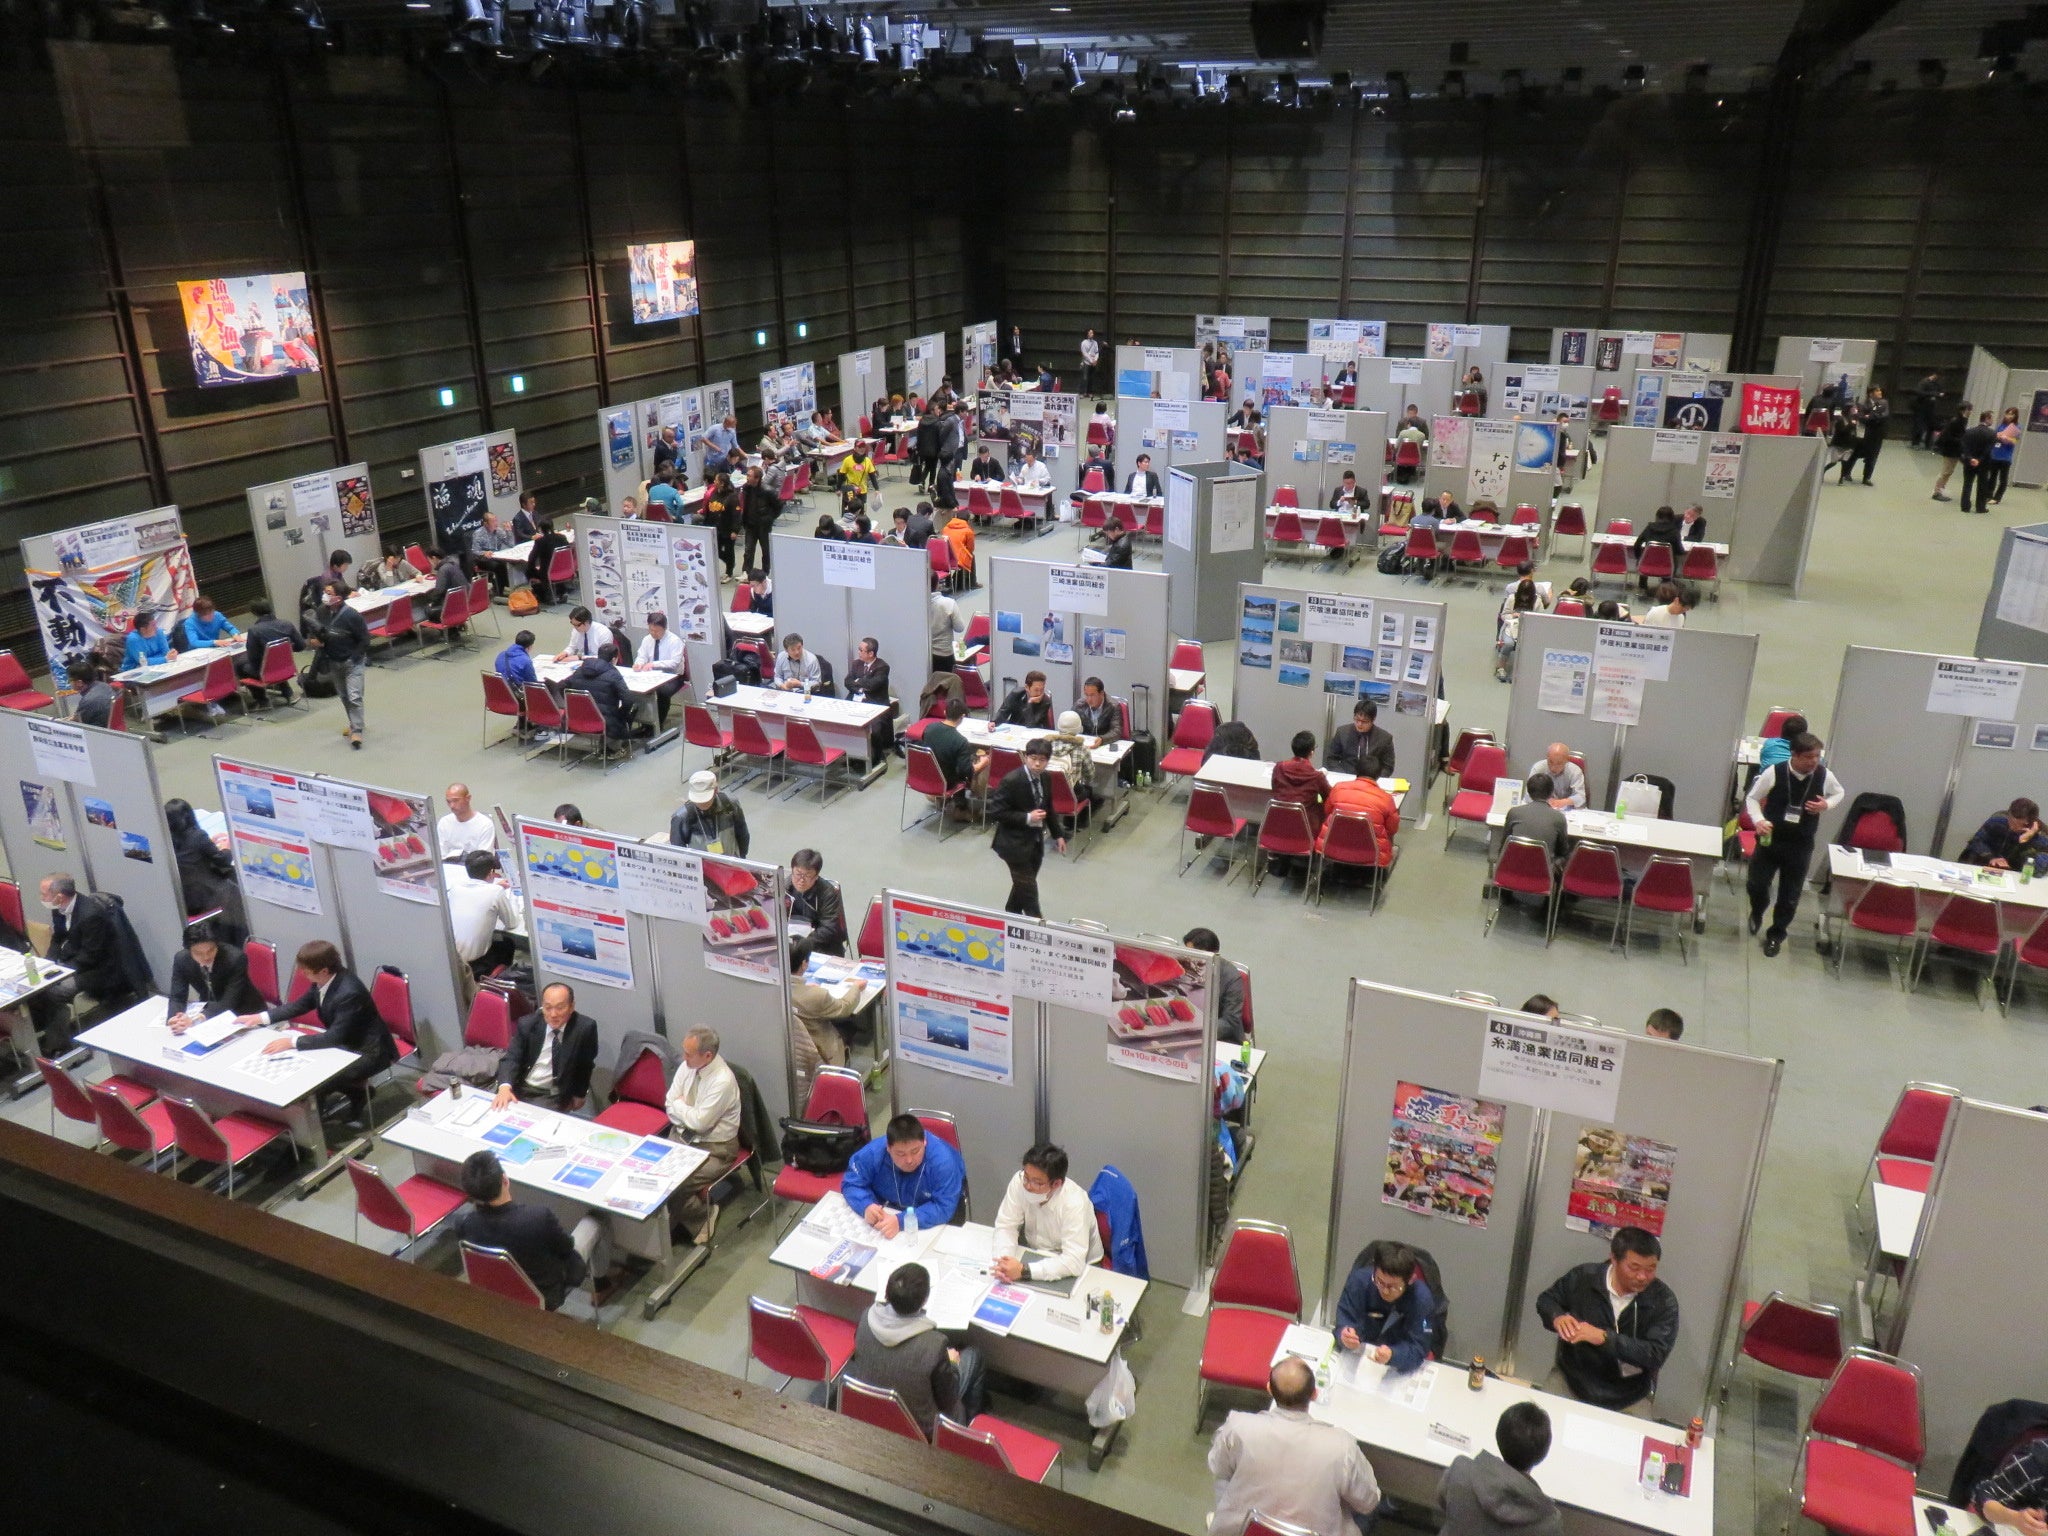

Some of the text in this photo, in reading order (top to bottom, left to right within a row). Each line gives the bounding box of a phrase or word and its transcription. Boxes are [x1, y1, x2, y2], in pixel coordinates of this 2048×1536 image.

[621, 849, 630, 857] 44
[1011, 929, 1022, 937] 44
[1009, 943, 1107, 969] 日本かつお・まぐろ漁業協同組合
[1494, 1024, 1507, 1034] 43
[1491, 1036, 1616, 1072] 糸満漁業協同組合
